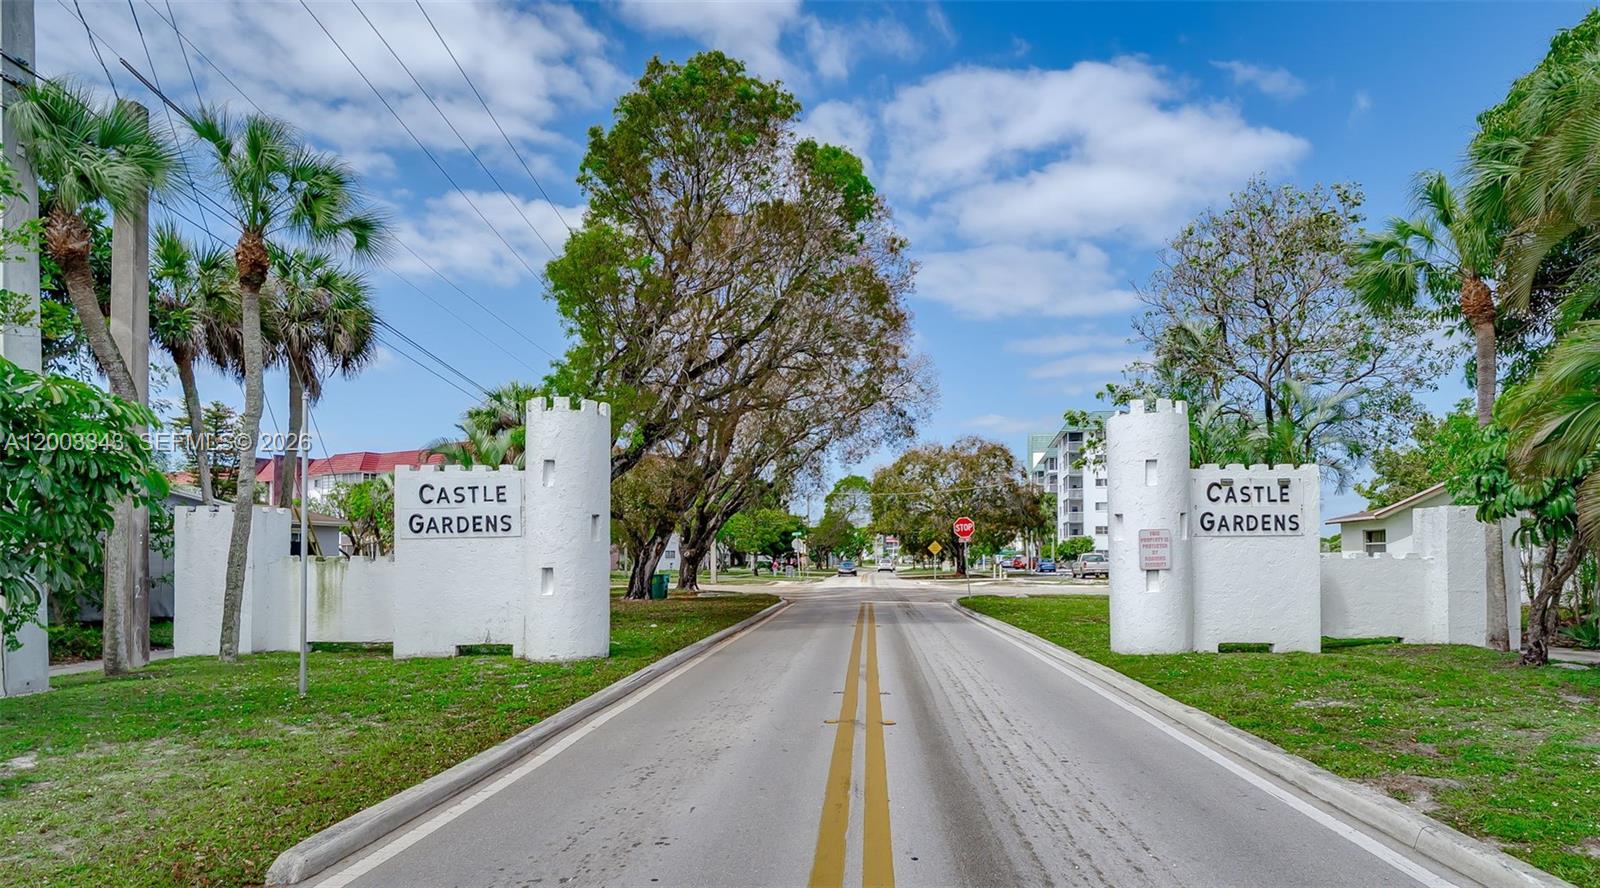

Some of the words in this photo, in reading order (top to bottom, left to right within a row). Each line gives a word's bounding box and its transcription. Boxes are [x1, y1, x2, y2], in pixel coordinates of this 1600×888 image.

[418, 483, 507, 504] CASTLE
[1206, 481, 1290, 503] CASTLE
[408, 513, 512, 534] GARDENS
[955, 522, 973, 532] STOP
[1199, 511, 1300, 532] GARDENS
